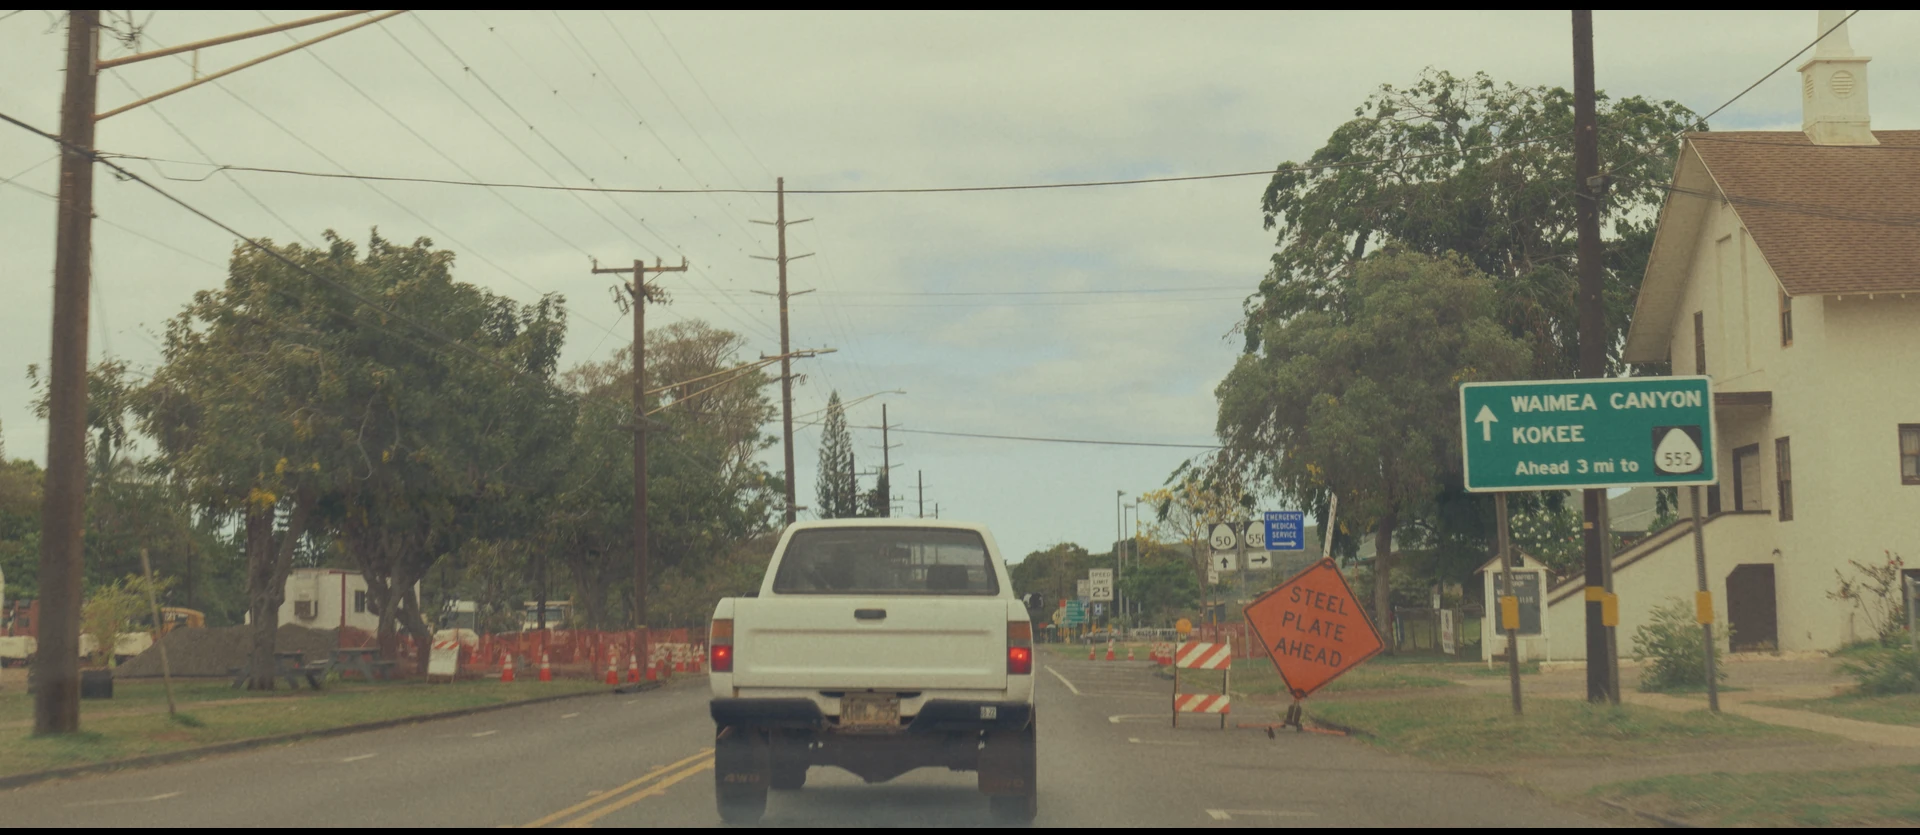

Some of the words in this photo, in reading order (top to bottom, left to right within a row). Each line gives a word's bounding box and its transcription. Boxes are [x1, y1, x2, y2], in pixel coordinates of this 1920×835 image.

[1511, 393, 1597, 413] WAIMEA
[1609, 390, 1702, 410] CANYON
[1512, 425, 1585, 444] KOKEE
[1515, 460, 1570, 476] Ahead
[1577, 459, 1588, 474] 3
[1594, 458, 1614, 473] mi
[1620, 458, 1639, 473] to
[1664, 452, 1693, 467] 552
[1266, 513, 1301, 521] EMERGENCY
[1271, 522, 1297, 530] MEDICAL
[1215, 536, 1231, 547] 50
[1272, 531, 1297, 539] SERVICE
[1092, 587, 1110, 598] 25
[1289, 585, 1349, 617] STEEL
[1281, 610, 1347, 643] PLATE
[1274, 637, 1342, 668] AHEAD
